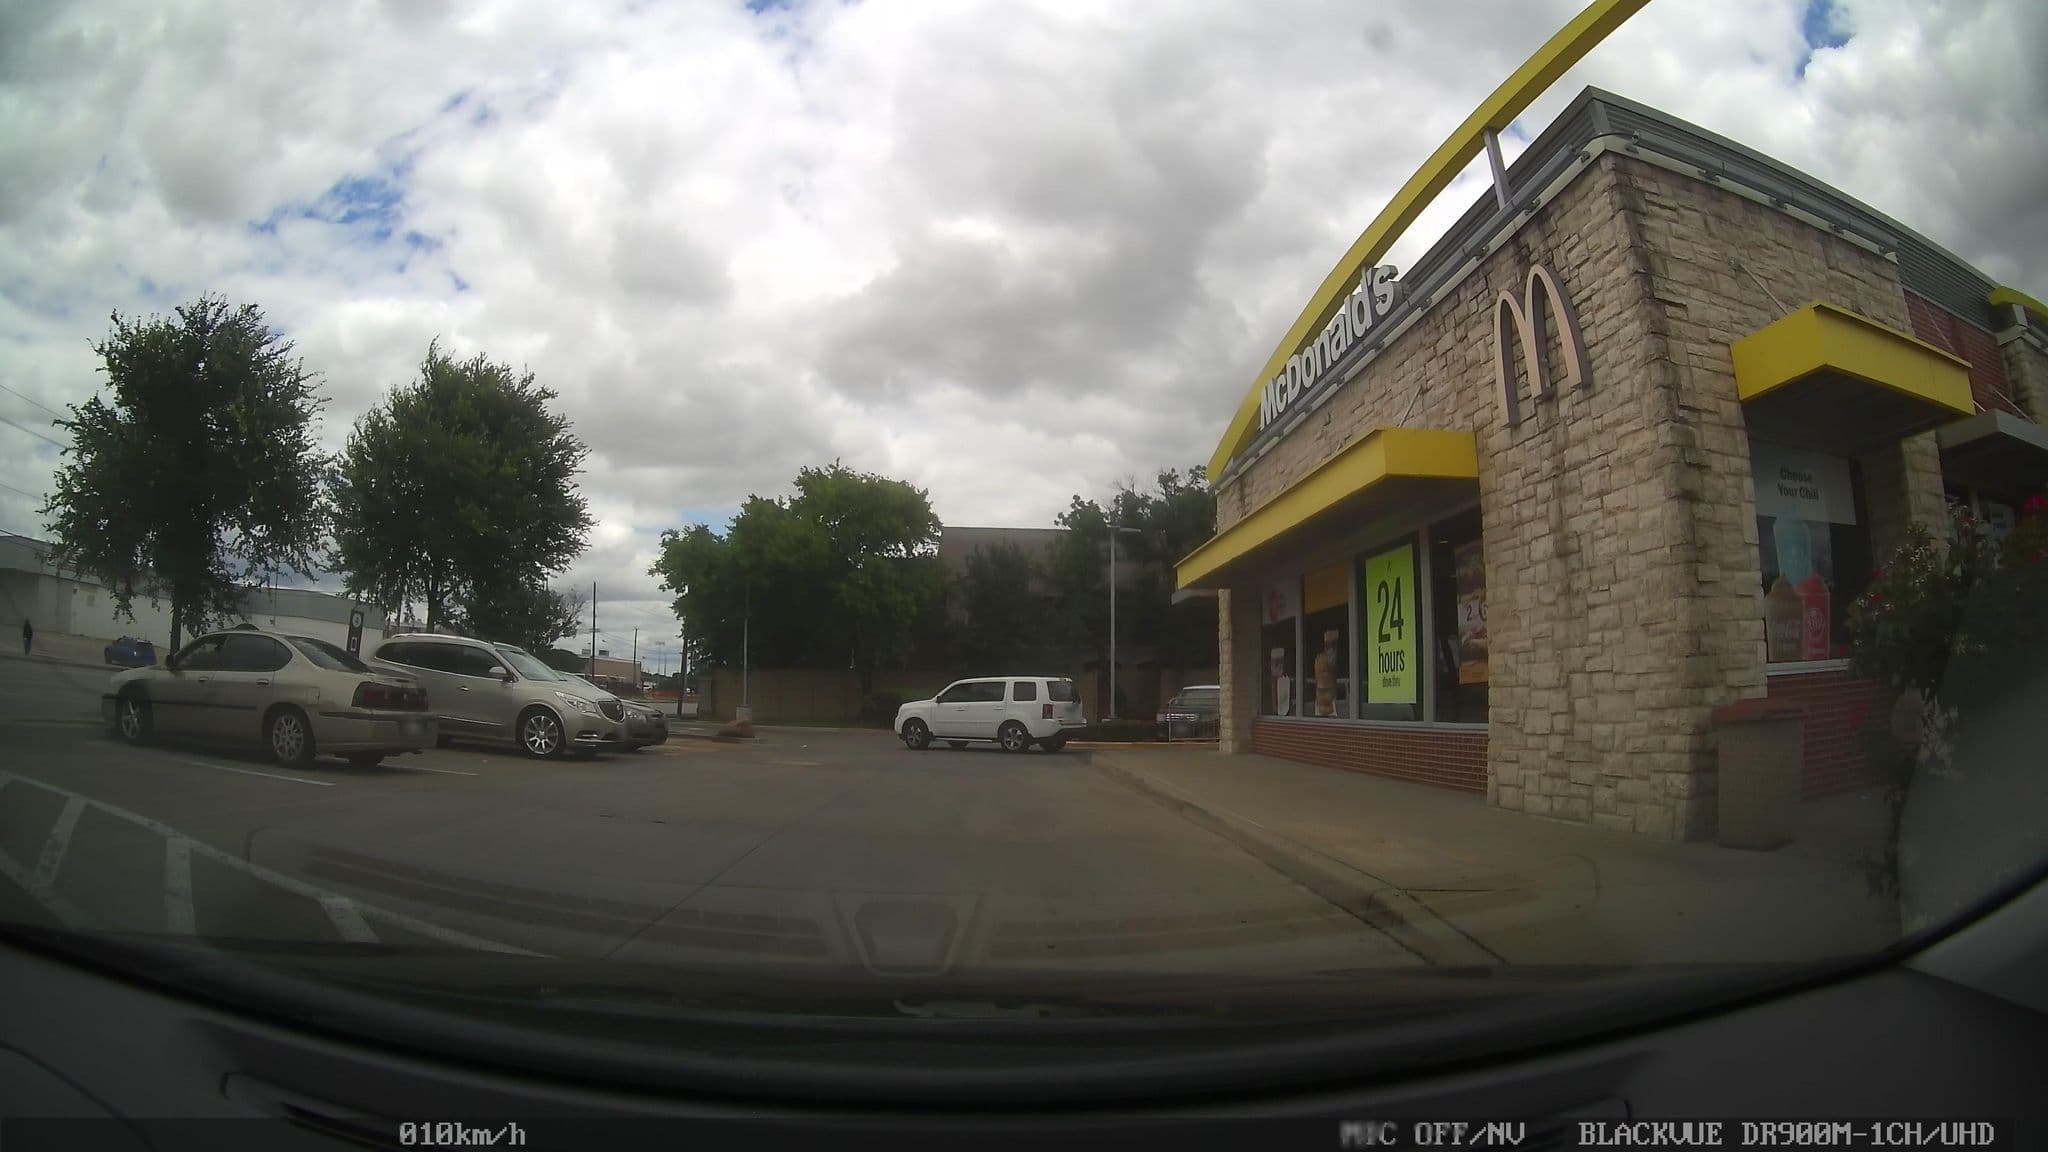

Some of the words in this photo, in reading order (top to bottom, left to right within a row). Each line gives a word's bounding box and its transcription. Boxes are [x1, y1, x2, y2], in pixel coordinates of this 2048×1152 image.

[1260, 264, 1399, 430] McDonald's
[1779, 467, 1813, 483] Choose
[1777, 482, 1798, 497] Your
[1799, 485, 1820, 501] Chill
[1377, 576, 1404, 643] 24
[1378, 646, 1405, 674] hours
